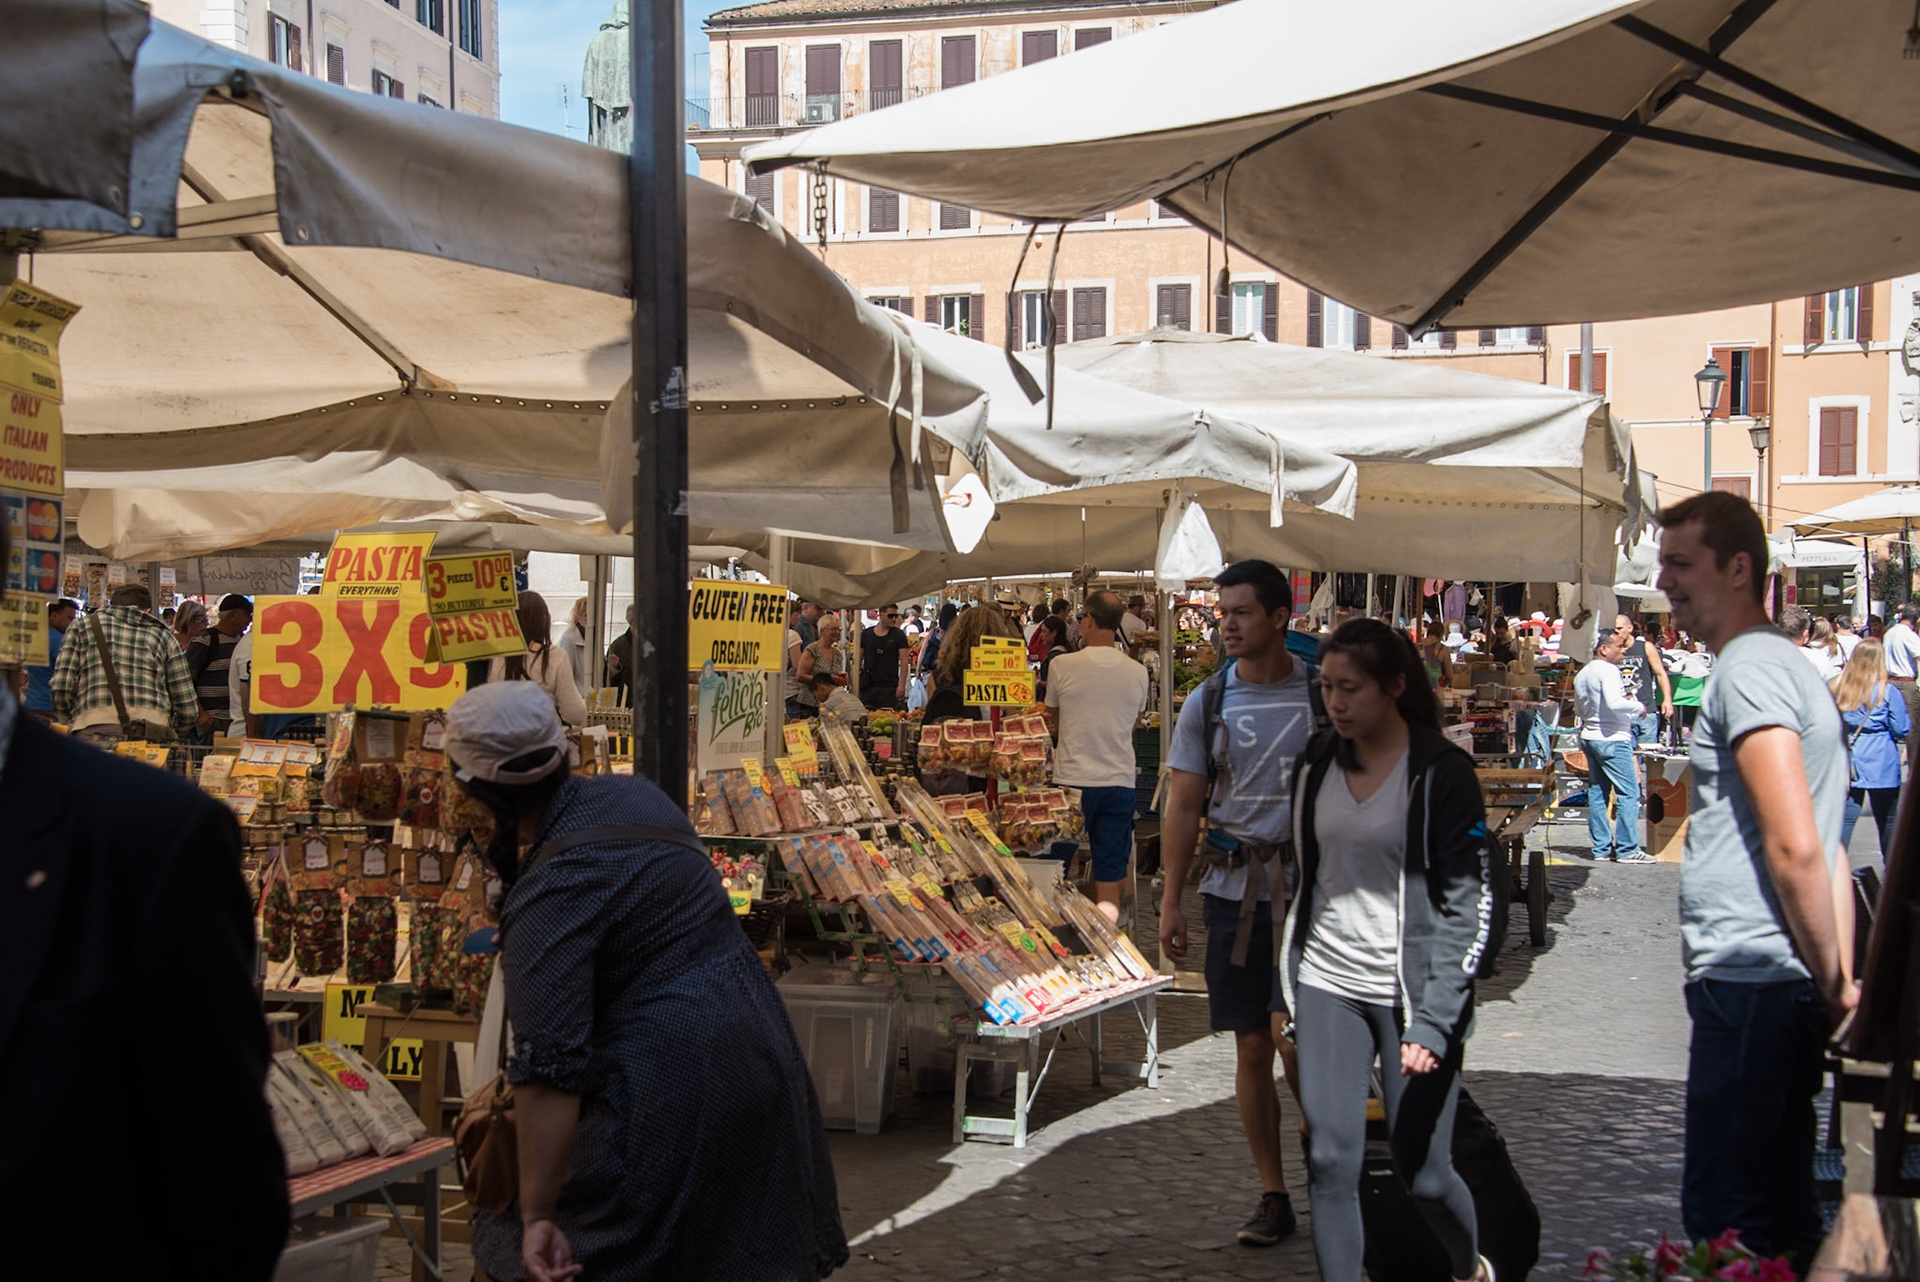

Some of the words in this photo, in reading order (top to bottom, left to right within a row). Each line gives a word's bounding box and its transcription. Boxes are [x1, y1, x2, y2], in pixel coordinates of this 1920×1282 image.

[11, 393, 41, 418] ONLY
[4, 425, 49, 452] ITALIAN
[0, 456, 57, 486] PRODUCTS
[326, 546, 423, 582] PASTA
[428, 562, 447, 599] 3
[447, 573, 474, 584] PIECES
[339, 585, 399, 596] EVERYTHING
[692, 588, 748, 621] GLUTEN
[751, 593, 785, 625] FREE
[436, 610, 520, 647] PASTA
[712, 640, 760, 665] ORGANIC
[975, 657, 981, 669] 5
[709, 670, 763, 746] felicia
[966, 684, 1007, 701] PASTA
[1237, 715, 1257, 748] S
[1279, 756, 1296, 790] F
[1461, 847, 1494, 975] Chartboost
